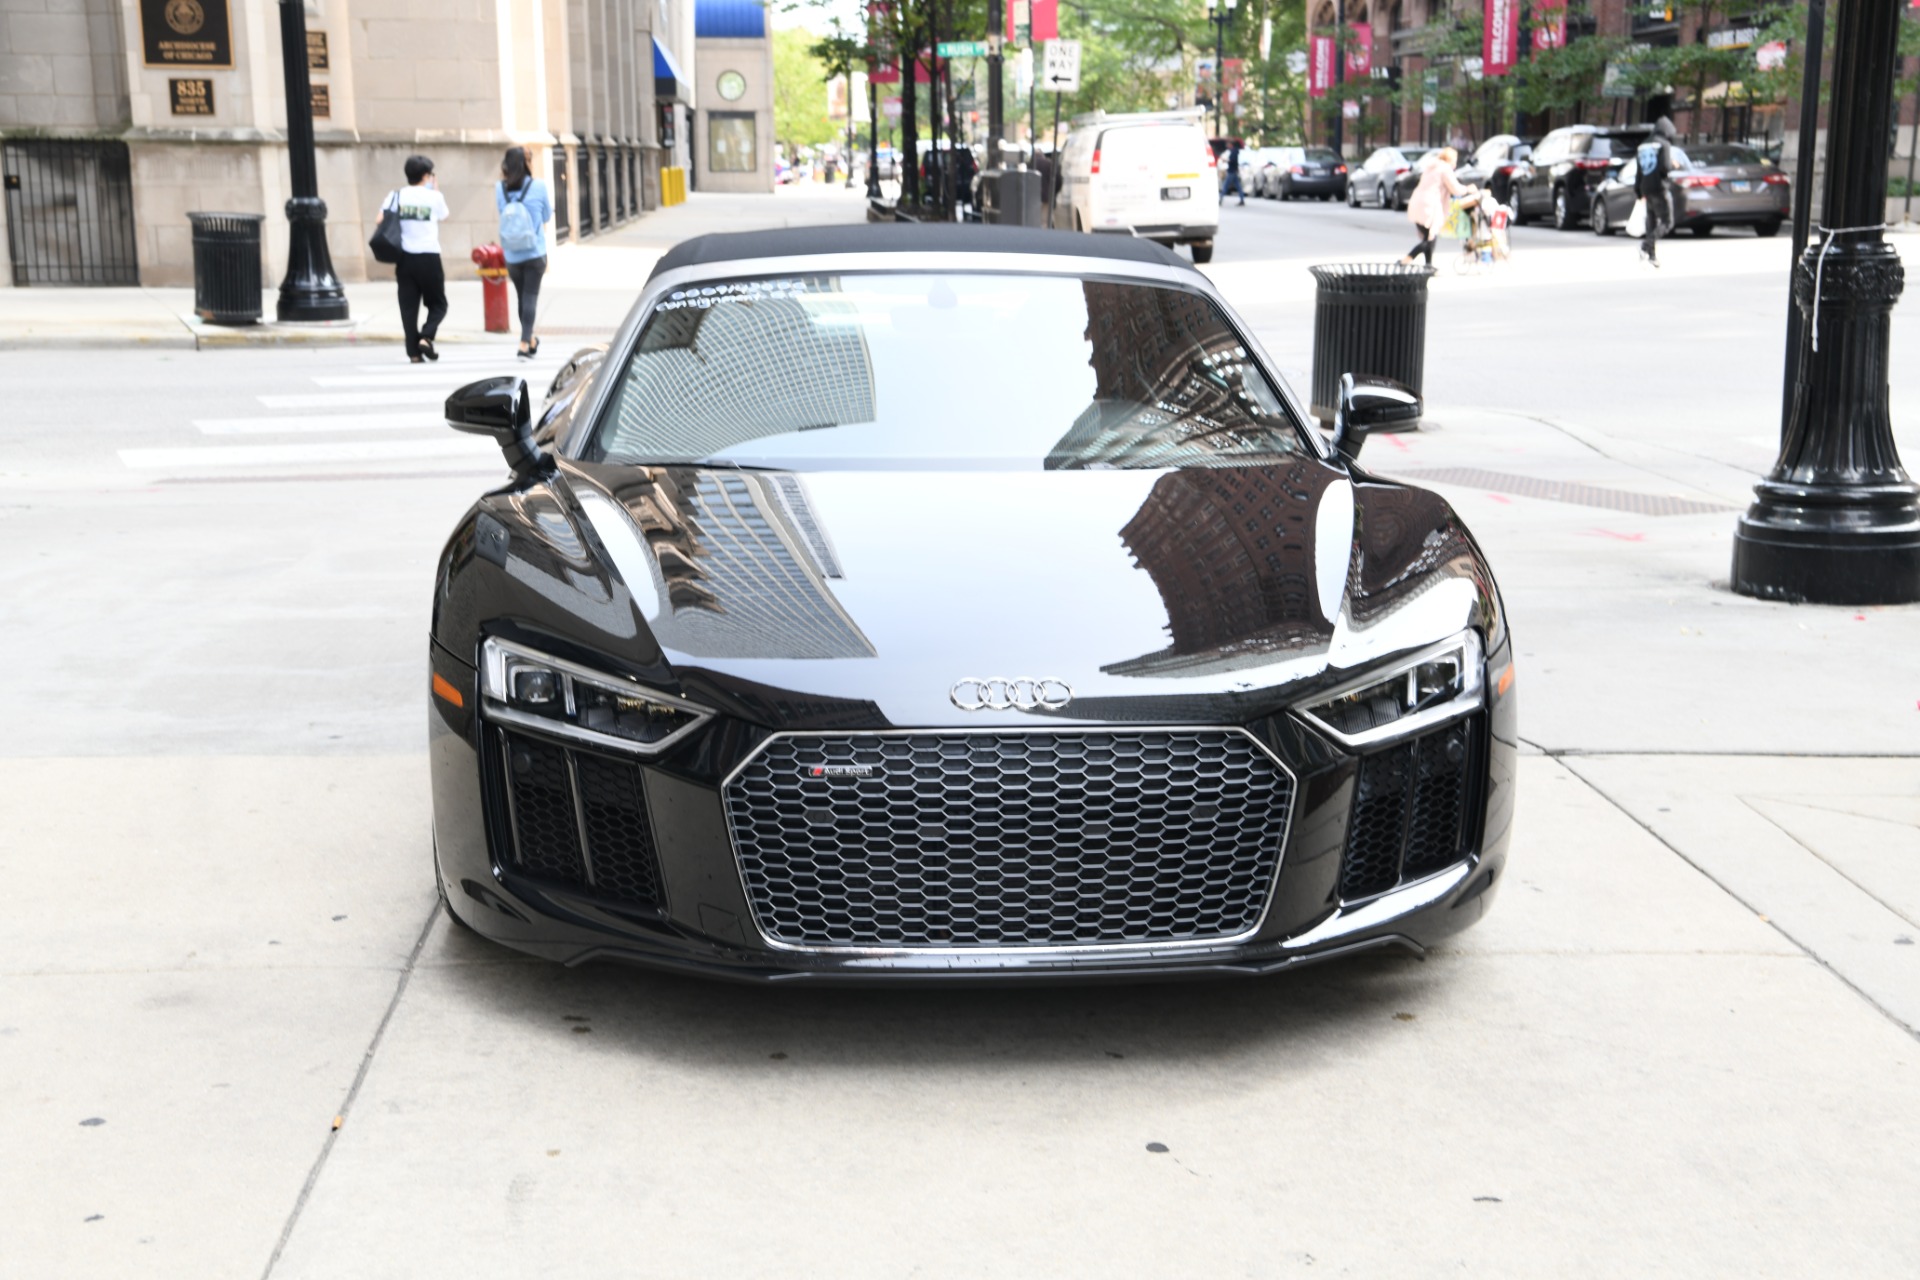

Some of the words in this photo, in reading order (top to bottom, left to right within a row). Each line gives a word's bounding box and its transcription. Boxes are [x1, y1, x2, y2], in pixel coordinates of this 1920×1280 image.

[1491, 0, 1504, 64] WELCOME
[158, 41, 217, 51] ARCHDIOCESE
[947, 42, 974, 57] RUSH
[1050, 45, 1074, 57] ONE
[163, 51, 175, 60] OF
[175, 51, 214, 60] CHICAGO
[1050, 60, 1074, 70] WAY
[1315, 38, 1324, 89] WELCOME
[176, 80, 206, 97] 835
